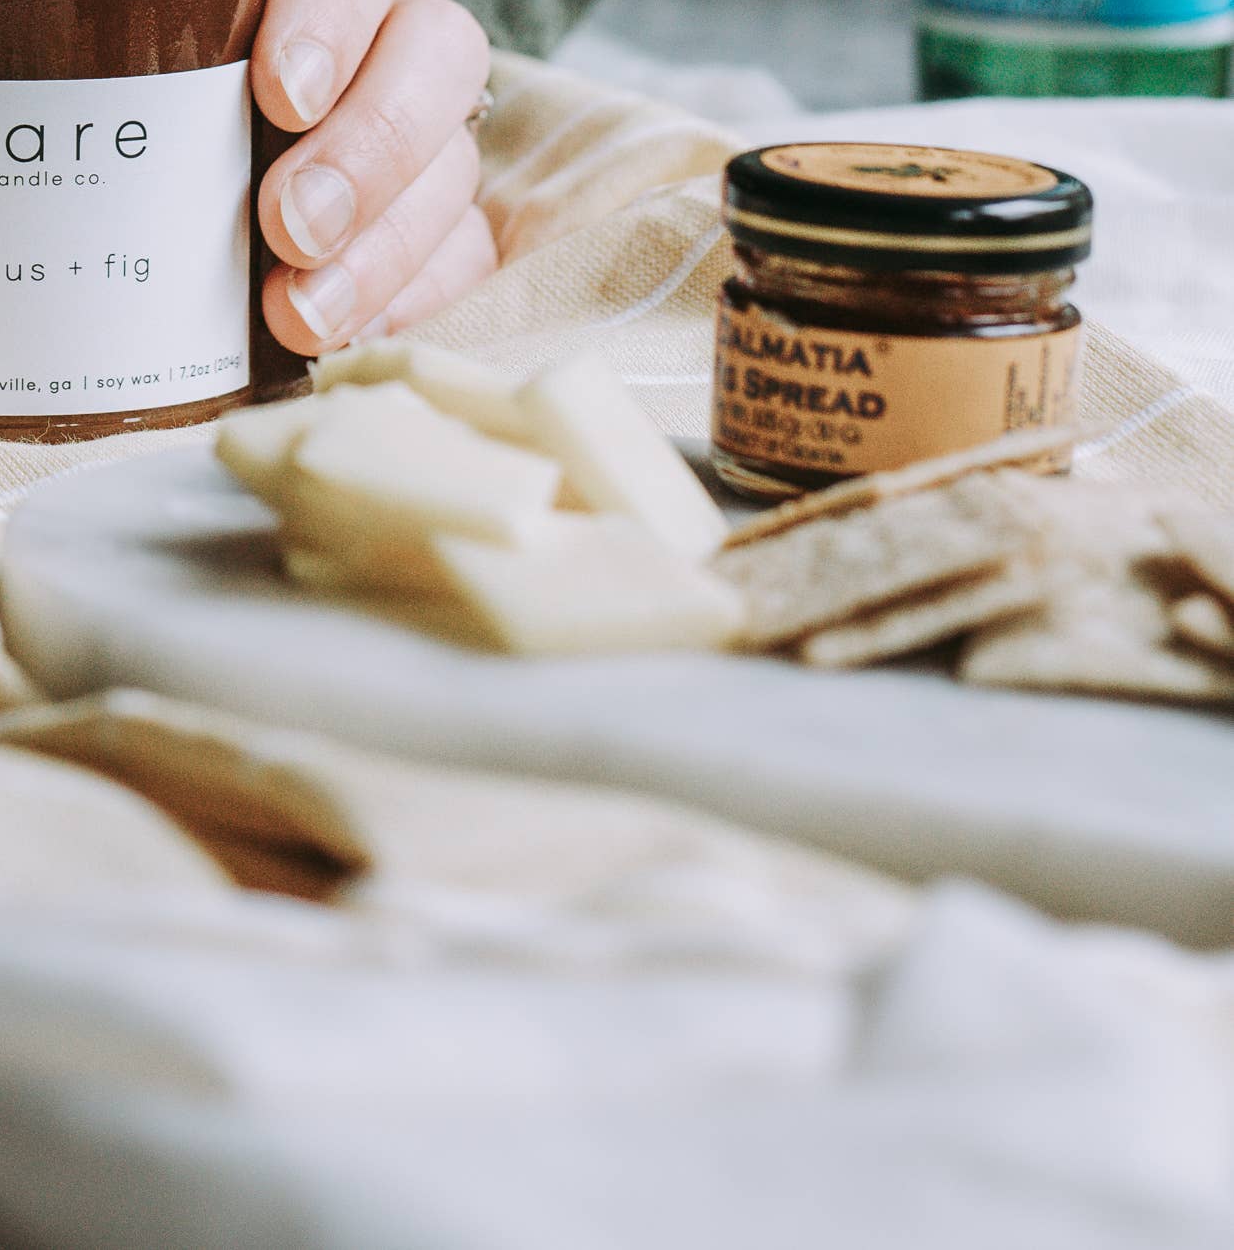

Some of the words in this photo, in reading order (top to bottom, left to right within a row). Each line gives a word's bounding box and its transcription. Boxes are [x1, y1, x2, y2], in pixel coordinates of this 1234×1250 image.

[74, 172, 107, 186] co.
[104, 253, 151, 283] fig
[49, 379, 72, 393] ga
[97, 376, 125, 390] soy
[131, 371, 161, 386] wax
[179, 362, 211, 380] 7.2oz
[744, 367, 887, 419] SPREAD
